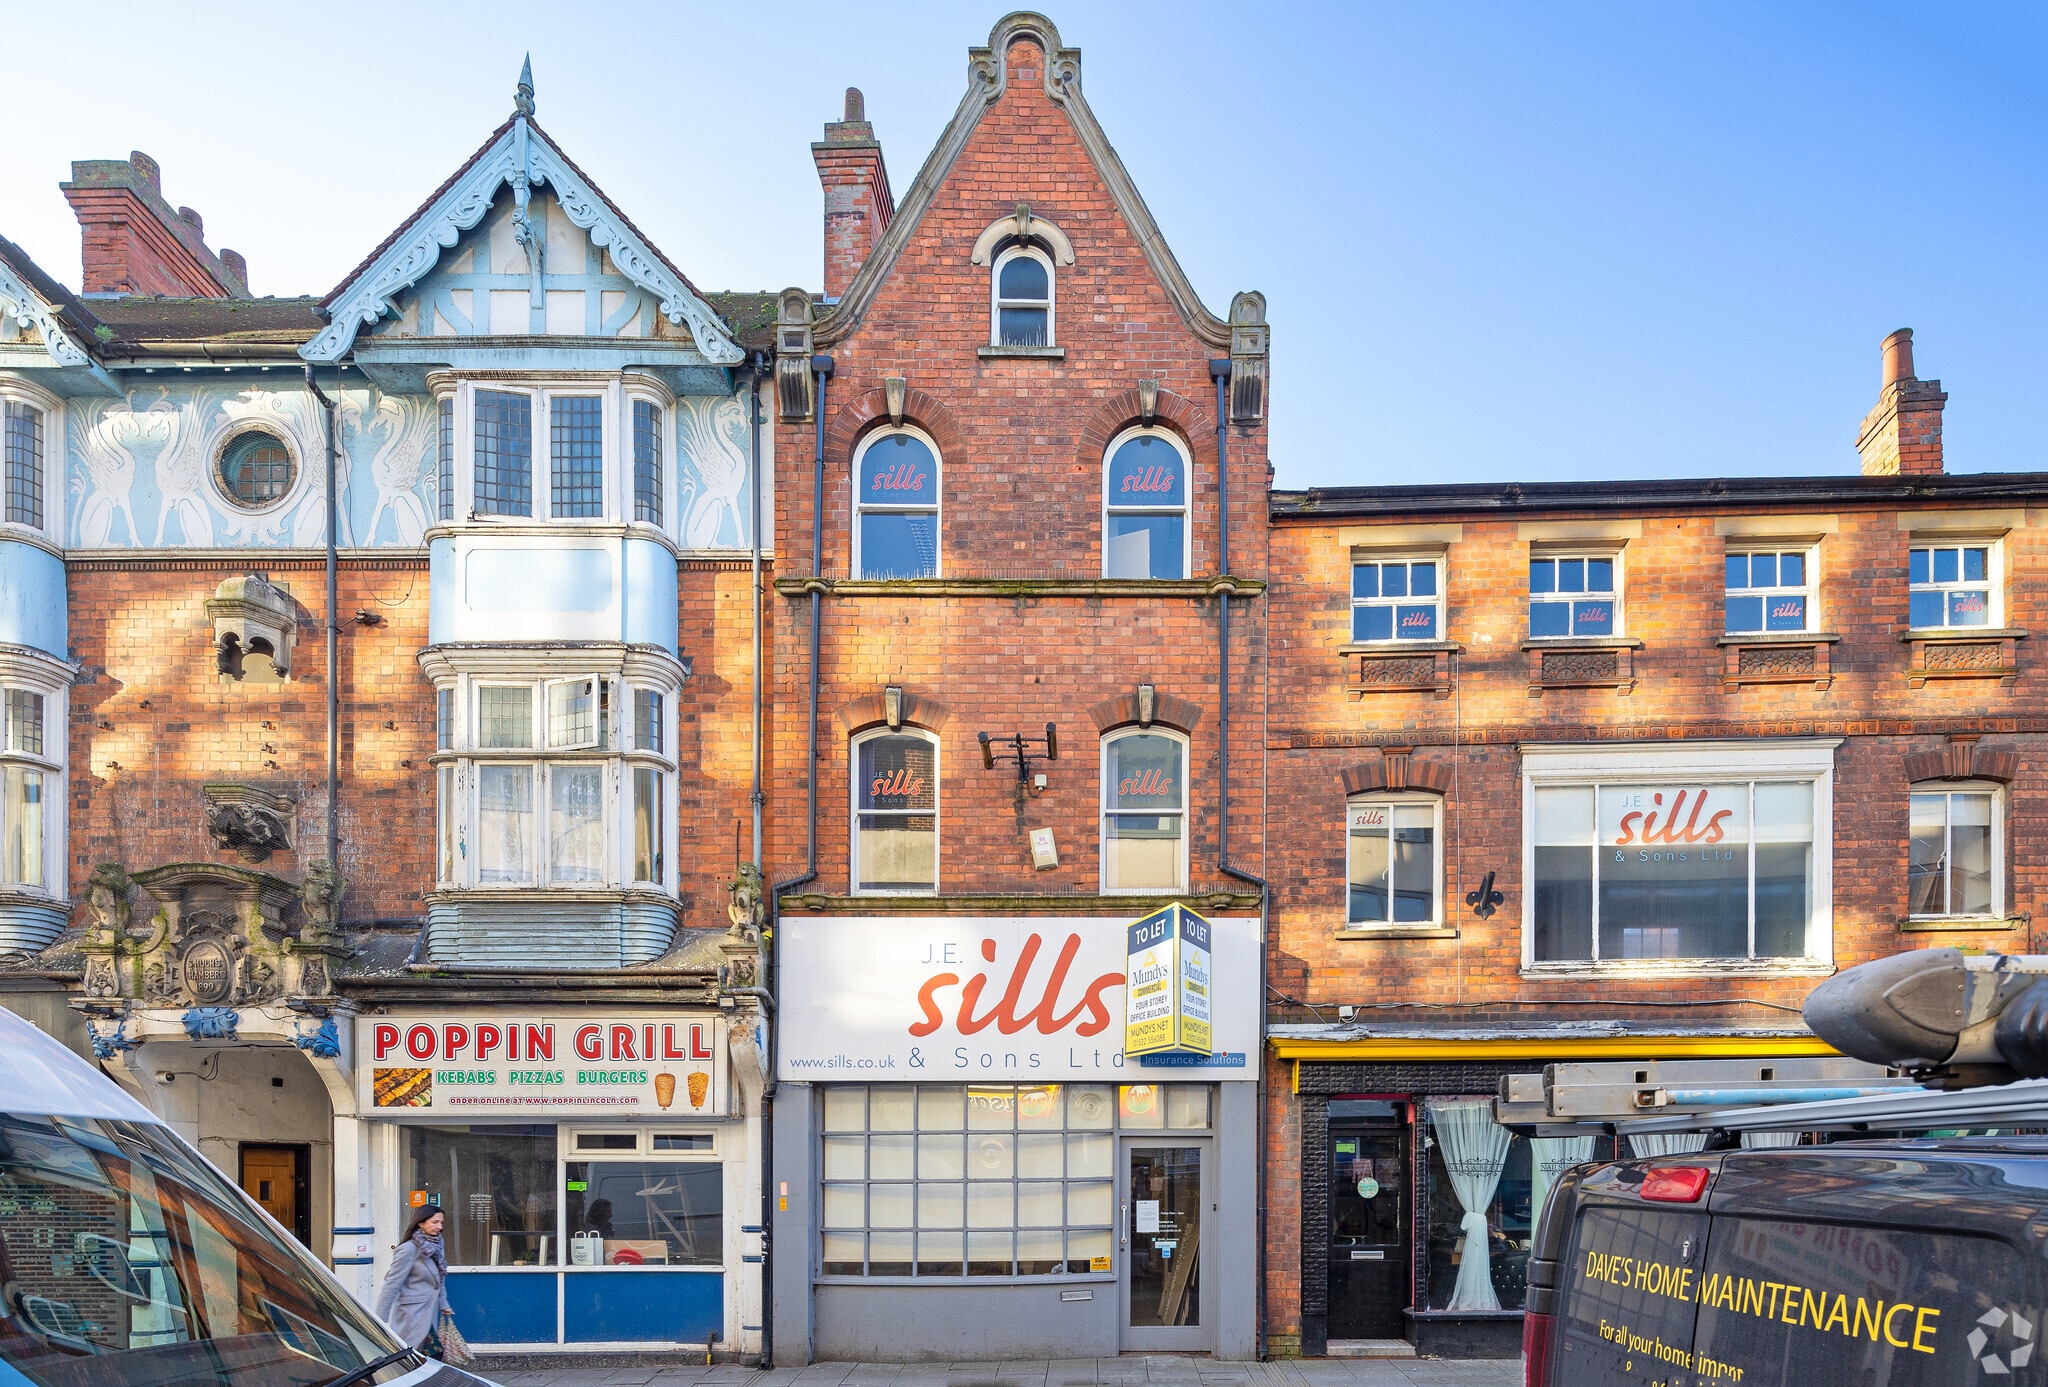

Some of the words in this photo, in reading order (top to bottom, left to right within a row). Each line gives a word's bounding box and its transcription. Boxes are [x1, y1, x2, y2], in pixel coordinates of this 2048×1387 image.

[872, 464, 926, 490] sills
[1121, 466, 1175, 493] sills
[1578, 607, 1608, 623] sills
[1772, 602, 1803, 618] sills
[1954, 597, 1985, 613] sills
[1402, 611, 1431, 627] sills
[871, 769, 925, 796] sills
[1119, 769, 1173, 796] sills
[1622, 795, 1645, 807] J.E.
[1356, 811, 1384, 825] sills
[1615, 789, 1733, 845] sills
[1615, 850, 1625, 862] &
[1640, 849, 1687, 862] Sons
[1701, 848, 1733, 860] Ltd
[1136, 927, 1148, 944] TO
[1151, 919, 1166, 939] LET
[1186, 918, 1195, 937] TO
[1197, 924, 1207, 943] LET
[921, 943, 963, 964] J.E.
[908, 932, 1126, 1037] sills
[1132, 964, 1168, 986] Mundys
[1136, 1000, 1148, 1010] FOUR
[1149, 995, 1168, 1007] STOREY
[1130, 1011, 1146, 1022] OFFICE
[1147, 1005, 1170, 1018] BUILDING
[374, 1023, 555, 1061] POPPIN
[574, 1023, 713, 1061] GRILL
[790, 1055, 896, 1069] www.sills.co.uk
[908, 1047, 925, 1068] &
[954, 1047, 1041, 1068] Sons
[1069, 1047, 1124, 1068] Ltd
[1145, 1055, 1194, 1064] Insurance
[1197, 1052, 1244, 1065] Solutions
[436, 1070, 496, 1085] KEBABS
[509, 1070, 565, 1085] PIZZAS
[577, 1070, 648, 1085] BURGERS
[1585, 1251, 1633, 1287] DAVE'S
[1634, 1260, 1693, 1302] HOME
[1695, 1271, 1940, 1354] MAINTENANCE
[1599, 1319, 1615, 1341] For
[1615, 1325, 1627, 1346] all
[1627, 1333, 1653, 1354] your
[1654, 1336, 1694, 1370] home
